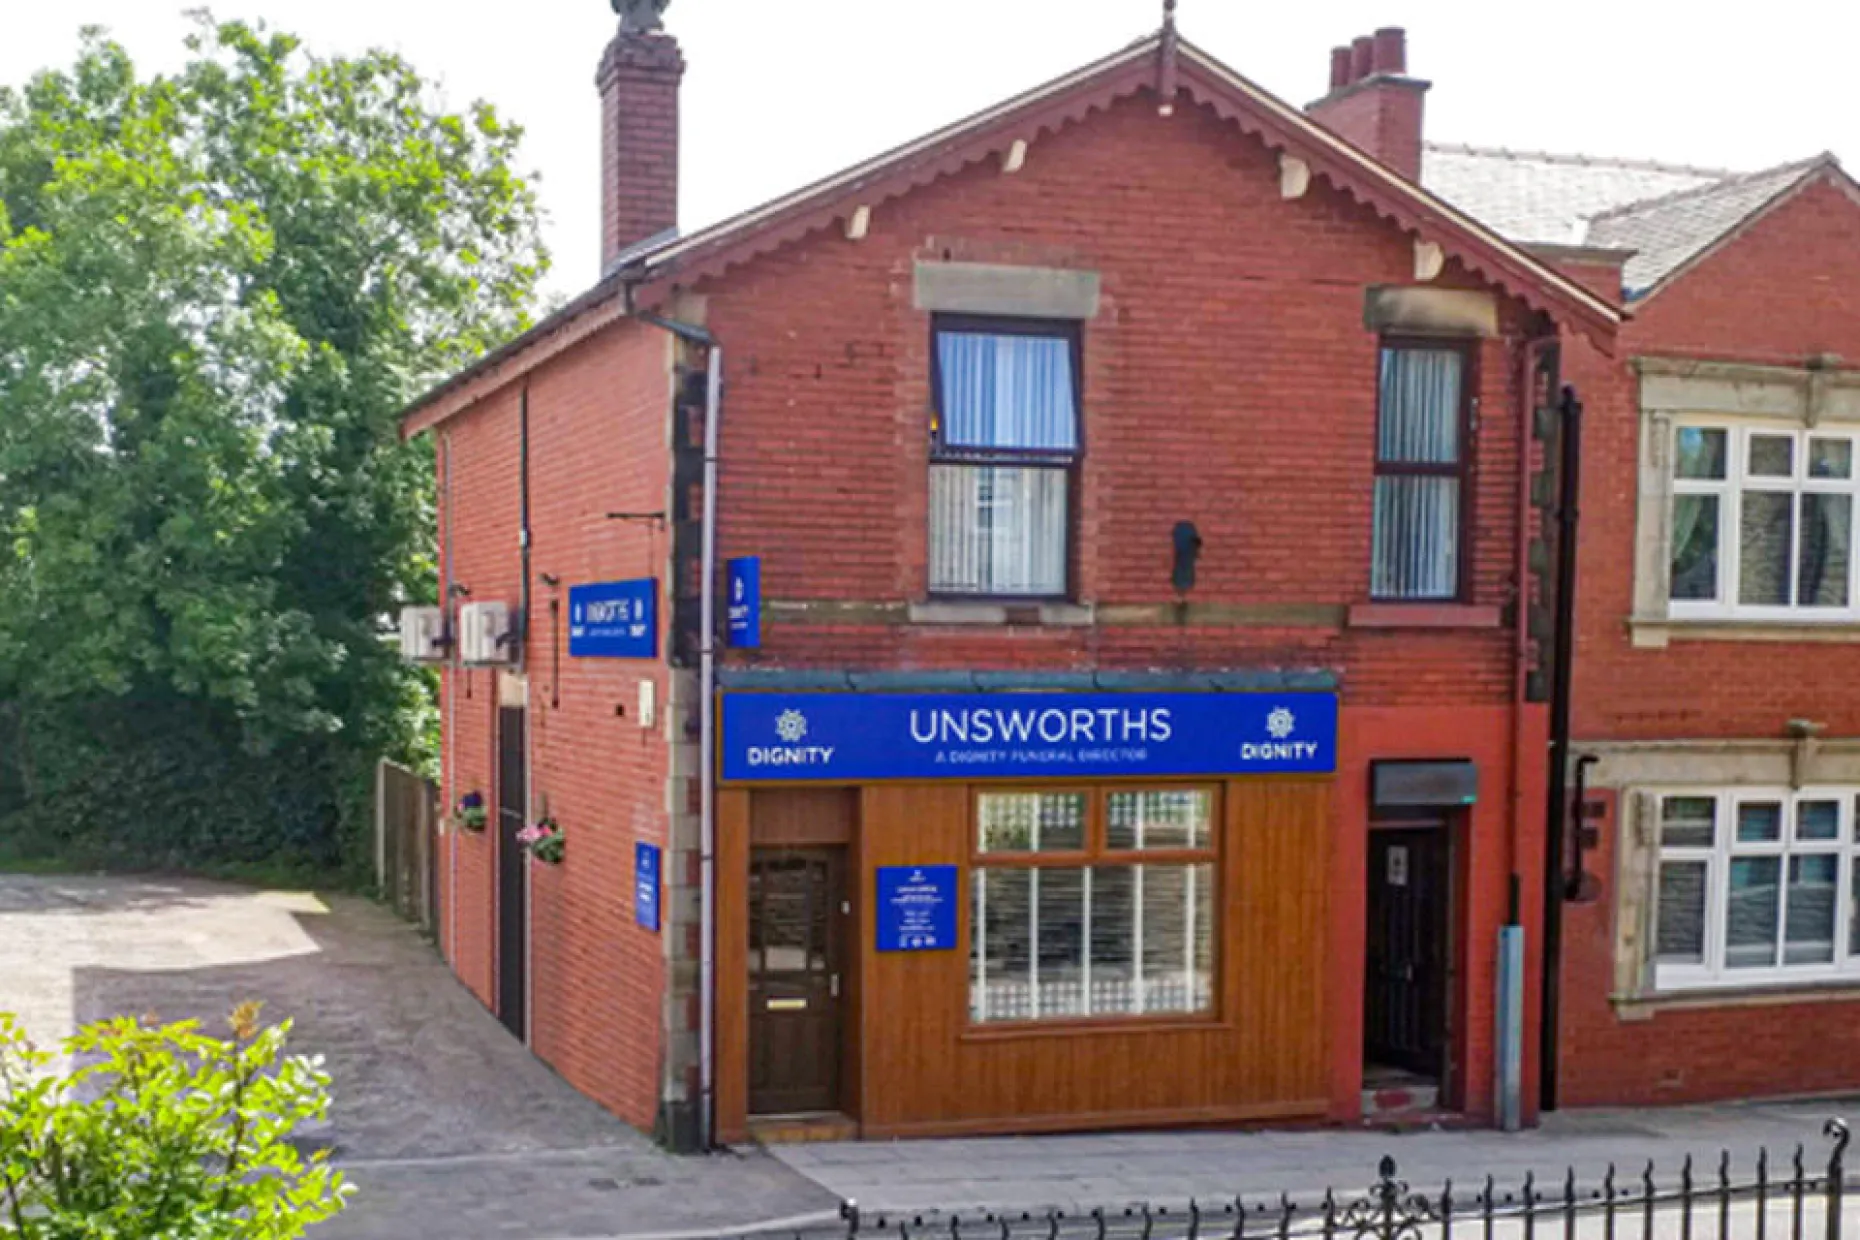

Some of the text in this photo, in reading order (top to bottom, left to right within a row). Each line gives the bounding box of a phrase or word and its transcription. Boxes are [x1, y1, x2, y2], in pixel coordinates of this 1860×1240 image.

[910, 708, 1173, 743] UNSWORTHS
[747, 747, 834, 765] DIGNITY
[934, 748, 1148, 763] A DIGNITY FUNERAL DIRECTOR
[1241, 741, 1318, 760] DIGNITY
